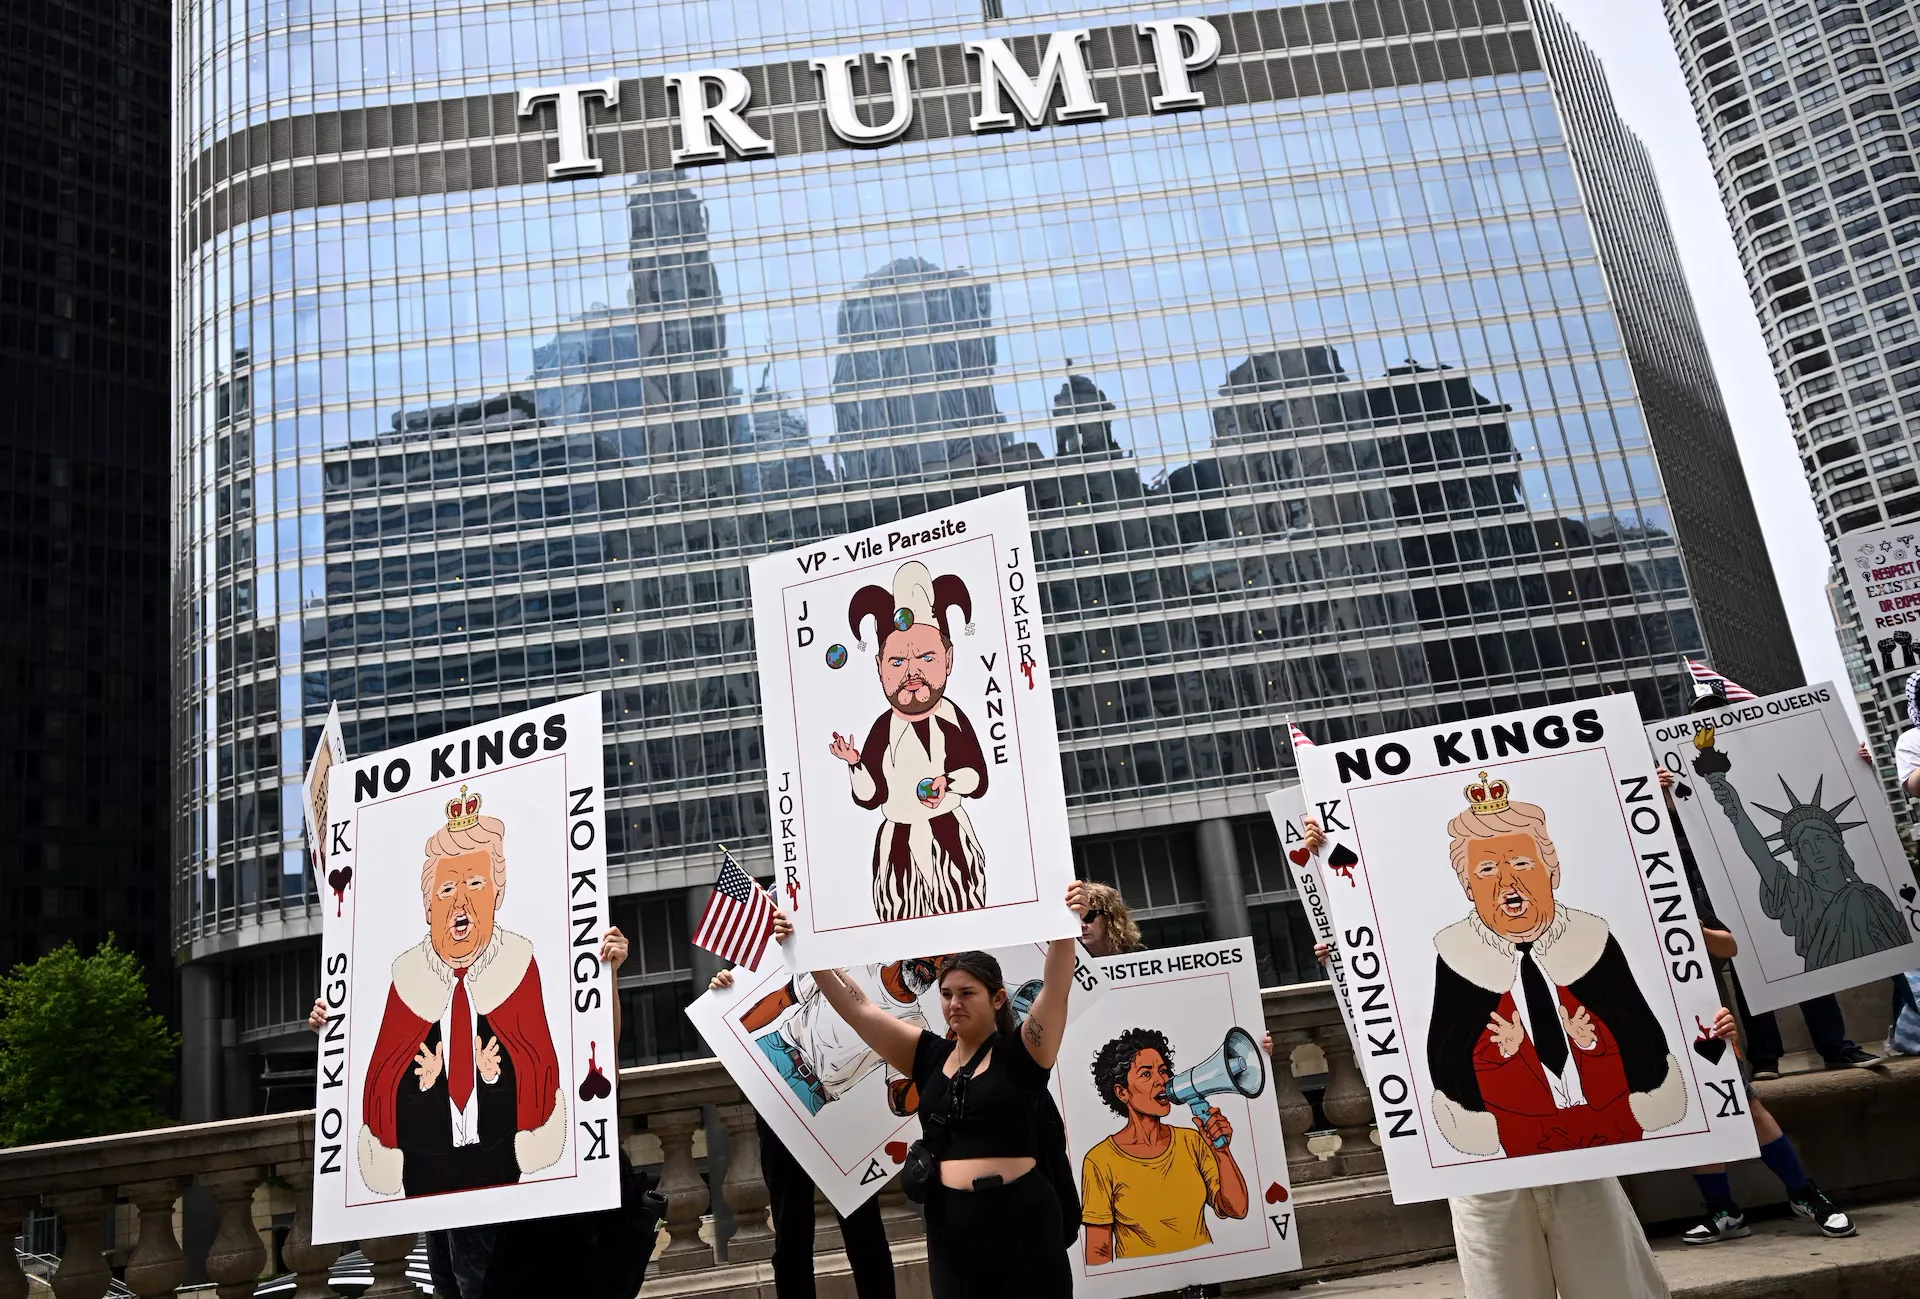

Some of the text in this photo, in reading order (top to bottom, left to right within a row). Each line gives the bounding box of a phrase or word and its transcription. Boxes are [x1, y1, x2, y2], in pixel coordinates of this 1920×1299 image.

[517, 15, 1222, 179] TRUMP
[796, 551, 827, 574] VP
[844, 537, 883, 562] Vile
[887, 519, 967, 552] Parasite
[1872, 561, 1915, 582] RESPECT
[1007, 547, 1034, 664] JOKER
[1878, 598, 1896, 613] OR
[981, 653, 1008, 764] VANCE
[1655, 688, 1831, 742] OUR BELOVED QUEENS
[354, 758, 411, 803] NO
[430, 713, 567, 783] KINGS
[1334, 708, 1604, 784] NO KINGS
[1664, 751, 1687, 778] Q
[330, 819, 352, 857] K
[778, 771, 800, 887] JOKER
[1285, 819, 1305, 845] A
[1316, 799, 1351, 834] K
[569, 786, 601, 1013] NO KINGS
[1300, 873, 1333, 939] HEROES
[1620, 775, 1704, 984] NO KINGS
[1167, 948, 1243, 973] HEROES
[1345, 926, 1418, 1139] NO KINGS
[320, 951, 348, 1175] NO KINGS
[1705, 1078, 1746, 1118] K
[580, 1118, 610, 1162] K
[859, 1157, 887, 1186] A
[1268, 1213, 1291, 1241] A
